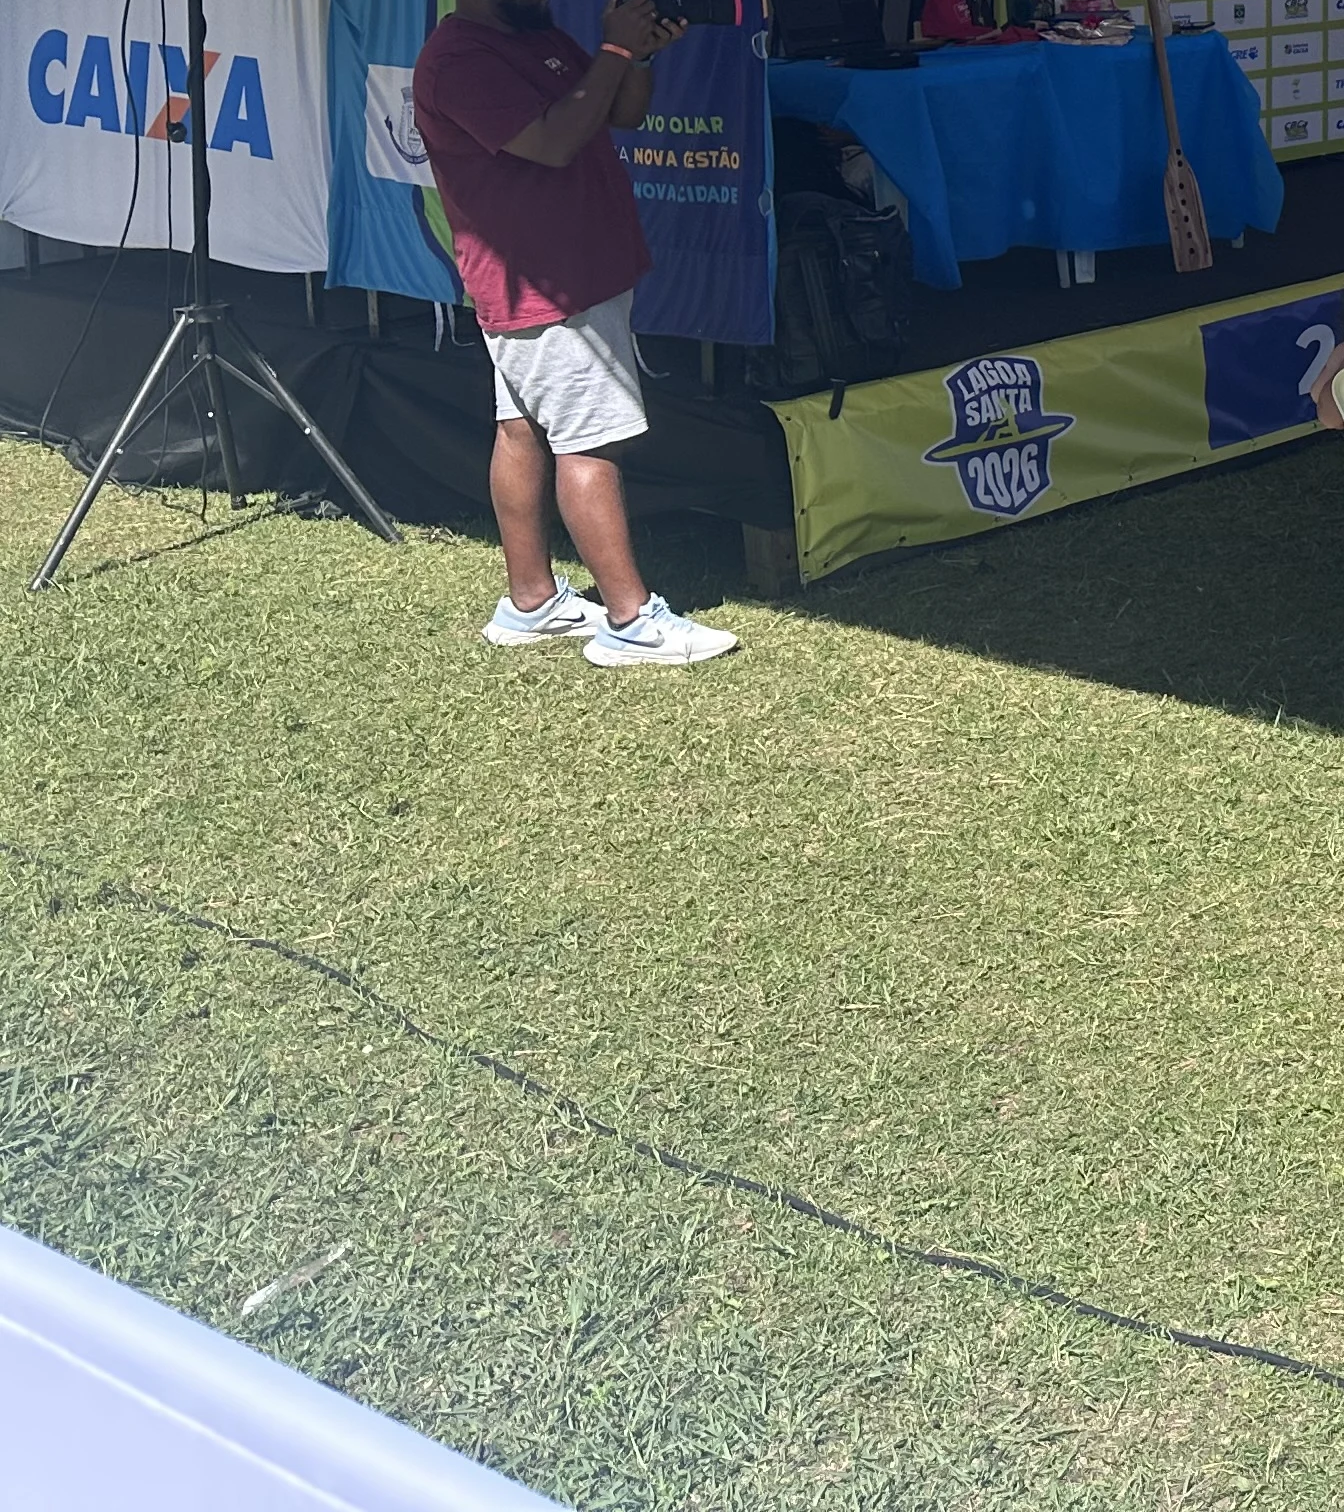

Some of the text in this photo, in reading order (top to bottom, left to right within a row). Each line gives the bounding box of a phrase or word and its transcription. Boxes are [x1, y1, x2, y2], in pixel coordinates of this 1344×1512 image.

[1231, 48, 1248, 60] GRE
[28, 29, 274, 161] CAIXA
[634, 147, 678, 168] NOVA
[957, 357, 1032, 402] LAGOA
[1295, 324, 1338, 395] 2
[964, 387, 1034, 428] SANTA
[967, 443, 1041, 509] 2026
